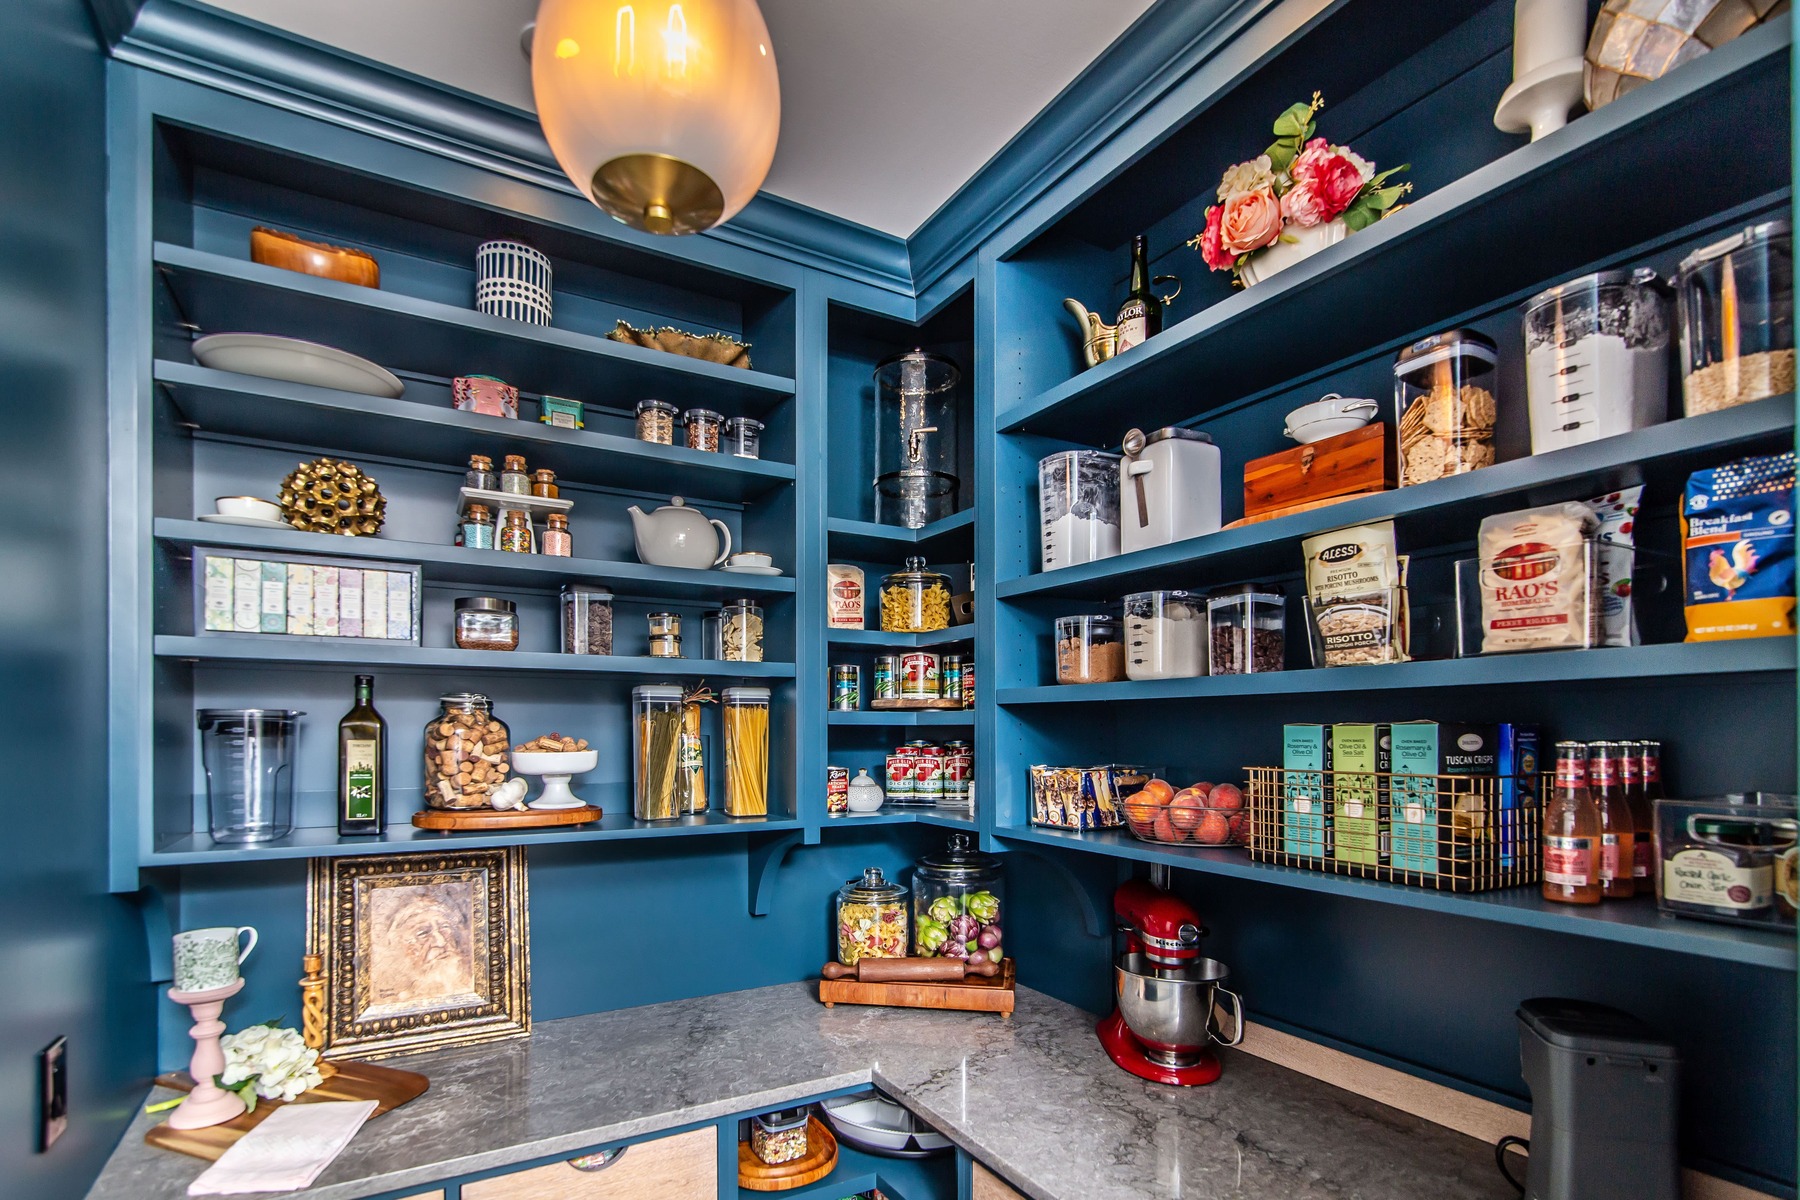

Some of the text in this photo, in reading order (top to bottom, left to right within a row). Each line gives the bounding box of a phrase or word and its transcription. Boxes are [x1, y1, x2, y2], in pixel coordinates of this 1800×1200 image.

[1117, 306, 1143, 324] AYLOR
[1690, 512, 1753, 527] Breakfast
[1690, 524, 1727, 537] Blend
[1322, 545, 1358, 560] ALESSI
[1315, 575, 1379, 591] WITH PORCINI MUSHROOMS
[1327, 571, 1358, 583] RISOTTO
[1496, 580, 1558, 601] RAO'S
[835, 601, 862, 609] RAO'S
[1501, 597, 1550, 608] HOMEMADE
[1496, 616, 1557, 628] PENNE RIGATE
[1327, 632, 1373, 644] RISOTTO
[1287, 743, 1312, 751] Rosemary
[1395, 744, 1426, 752] Rosemary
[1445, 755, 1493, 765] TUSCAN CRISPS
[1155, 938, 1199, 948] Kitchen
